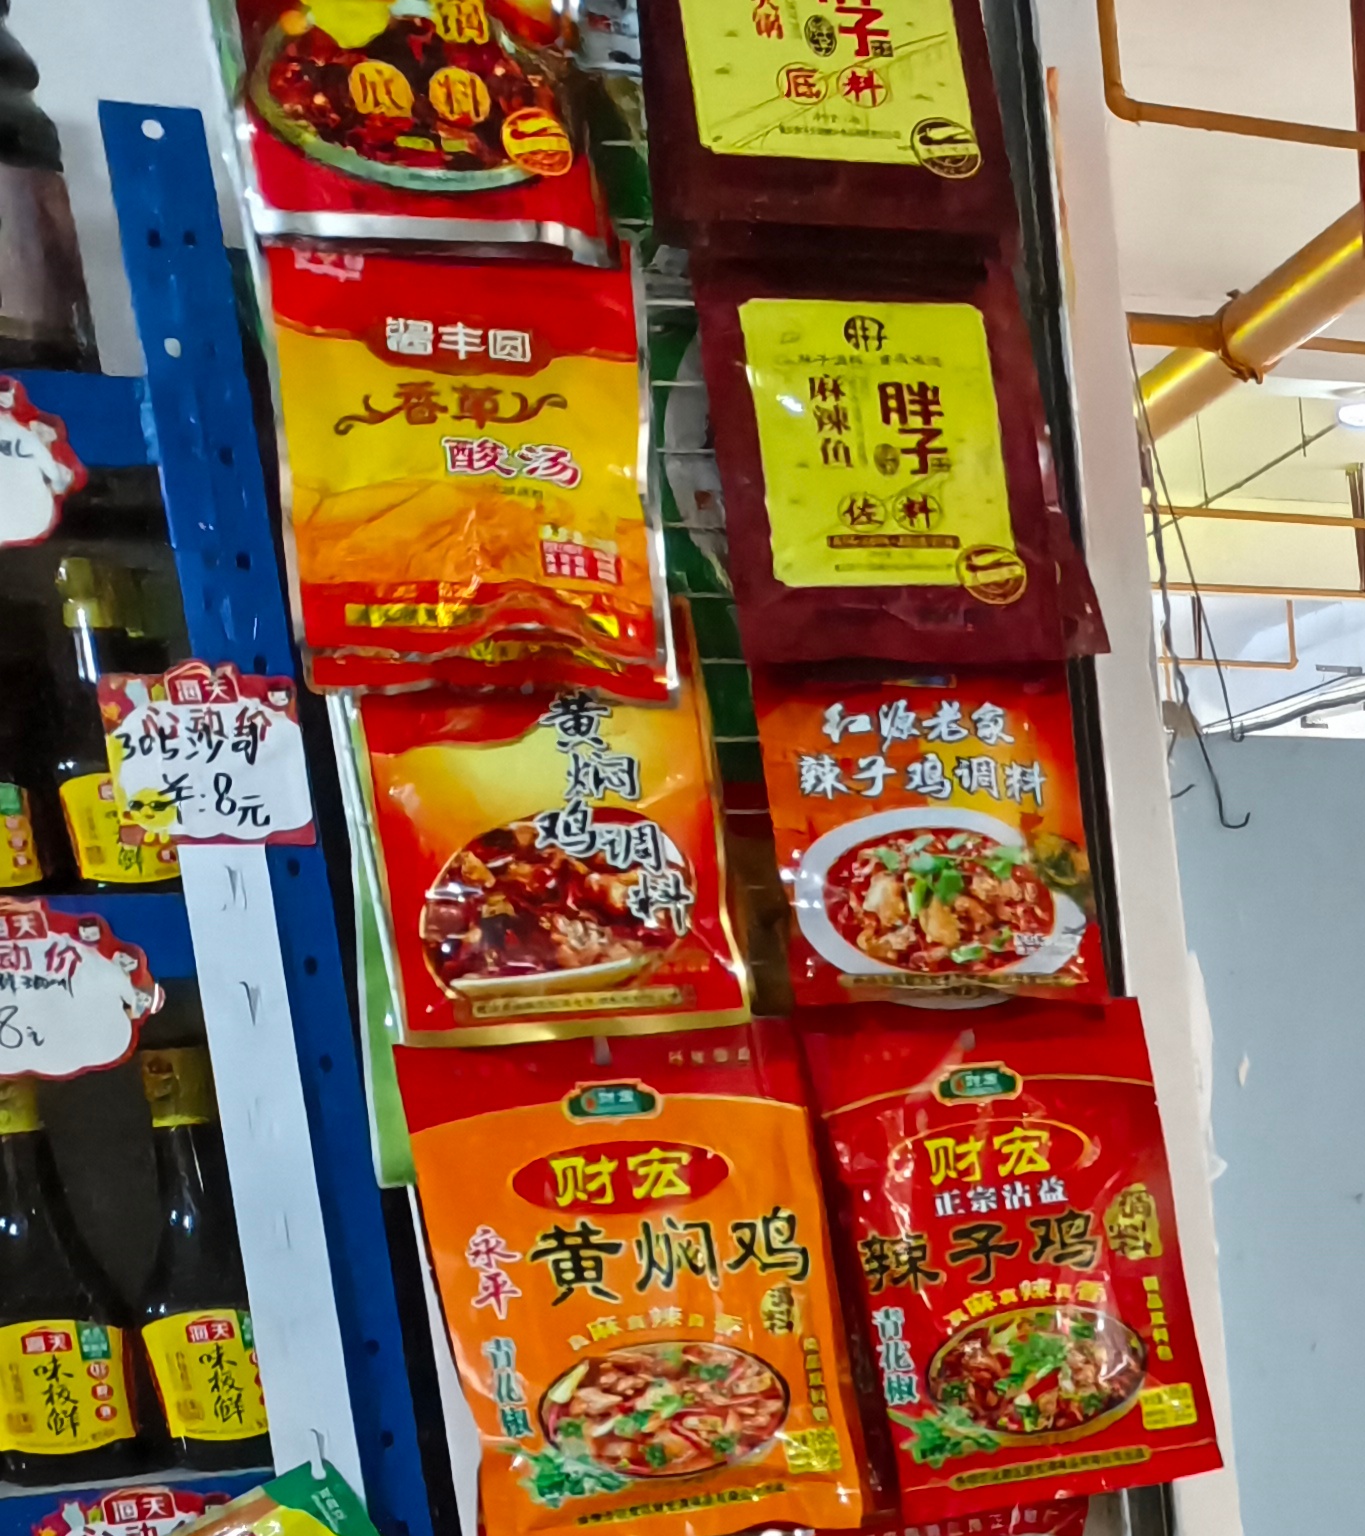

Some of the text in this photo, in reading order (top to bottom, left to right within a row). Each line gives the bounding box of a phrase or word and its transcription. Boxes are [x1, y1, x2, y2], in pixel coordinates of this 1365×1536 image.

[778, 63, 888, 108] 底料
[877, 381, 949, 475] 胖子
[441, 436, 582, 488] 酸汤
[141, 705, 272, 742] 心动价
[798, 753, 1048, 806] 辣子鸡调料
[549, 1146, 693, 1207] 财宏
[923, 1126, 1052, 1187] 财宏
[934, 1175, 1070, 1219] 正宗沾益
[463, 1223, 524, 1322] 永平
[526, 1205, 812, 1307] 黄焖鸡
[856, 1207, 1104, 1296] 辣子鸡
